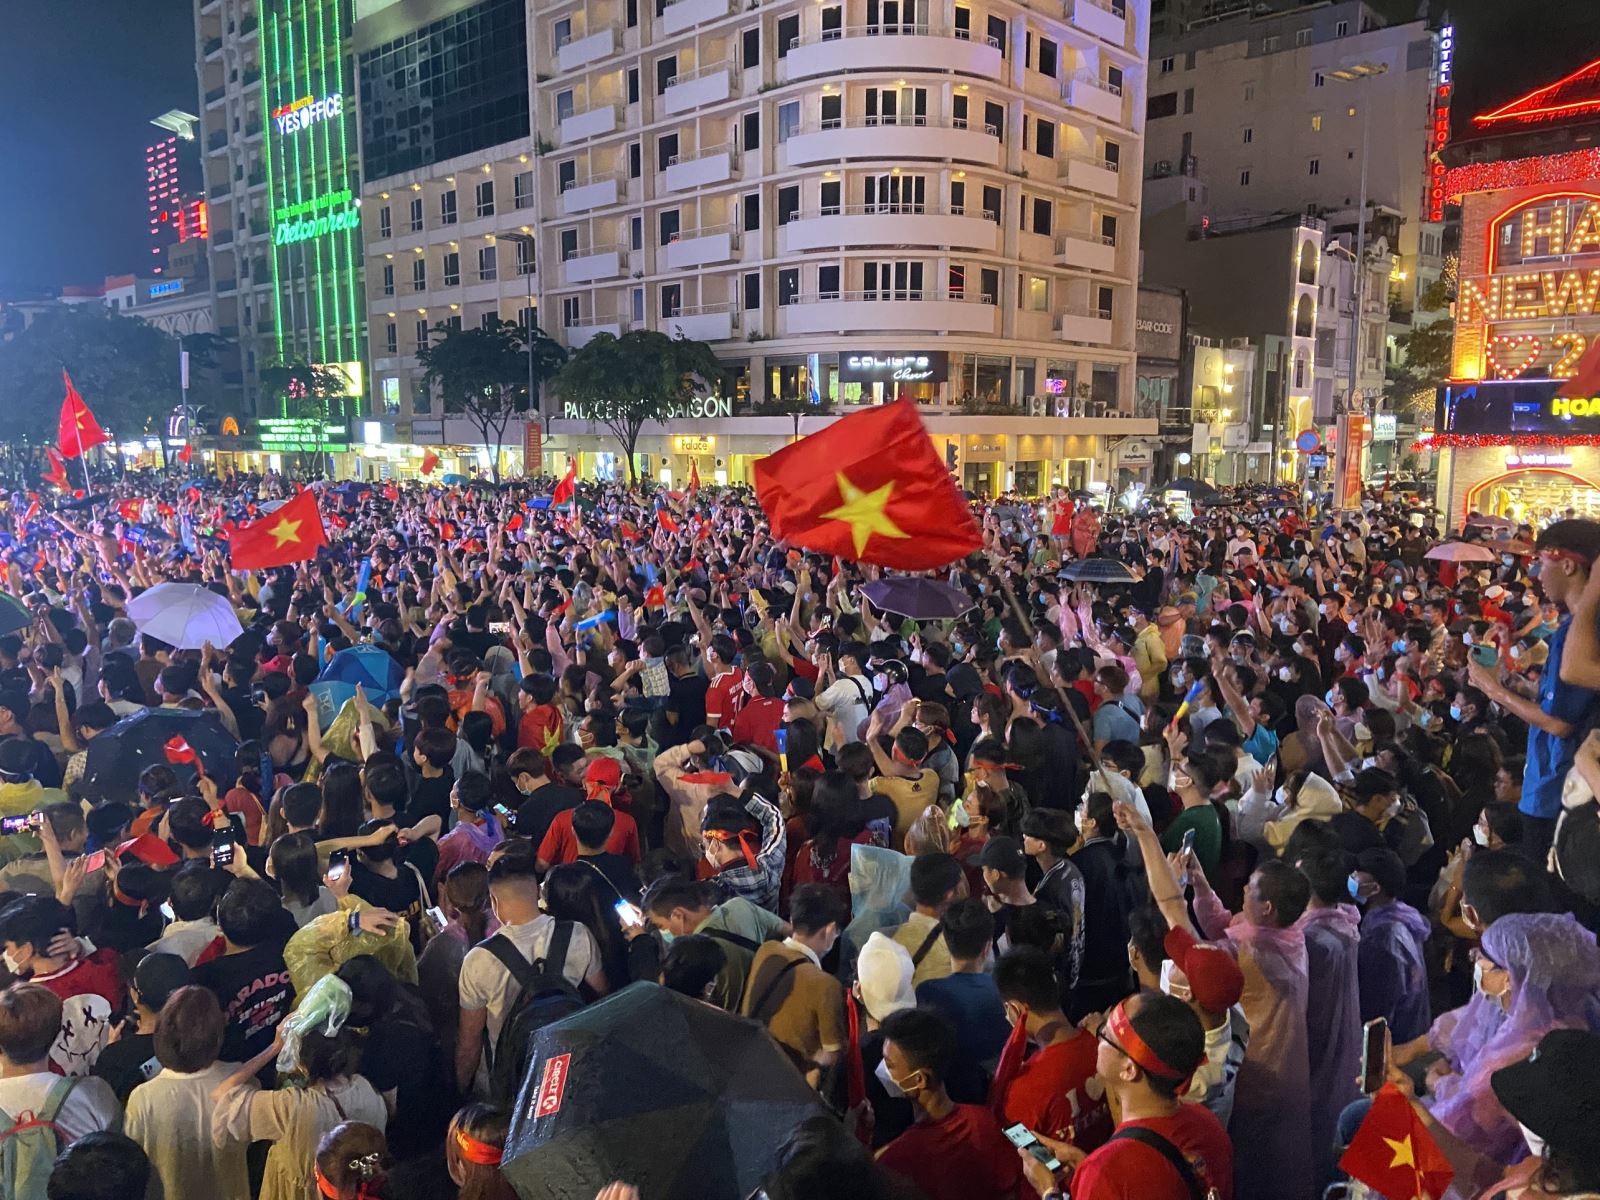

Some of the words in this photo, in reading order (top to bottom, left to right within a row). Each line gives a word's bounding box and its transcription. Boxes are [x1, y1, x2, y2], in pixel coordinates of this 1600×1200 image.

[1441, 26, 1453, 84] HOTEL
[1459, 269, 1600, 322] NEW
[667, 396, 733, 418] SAIGON
[681, 439, 708, 451] Palace
[549, 1060, 562, 1094] CIRCLE
